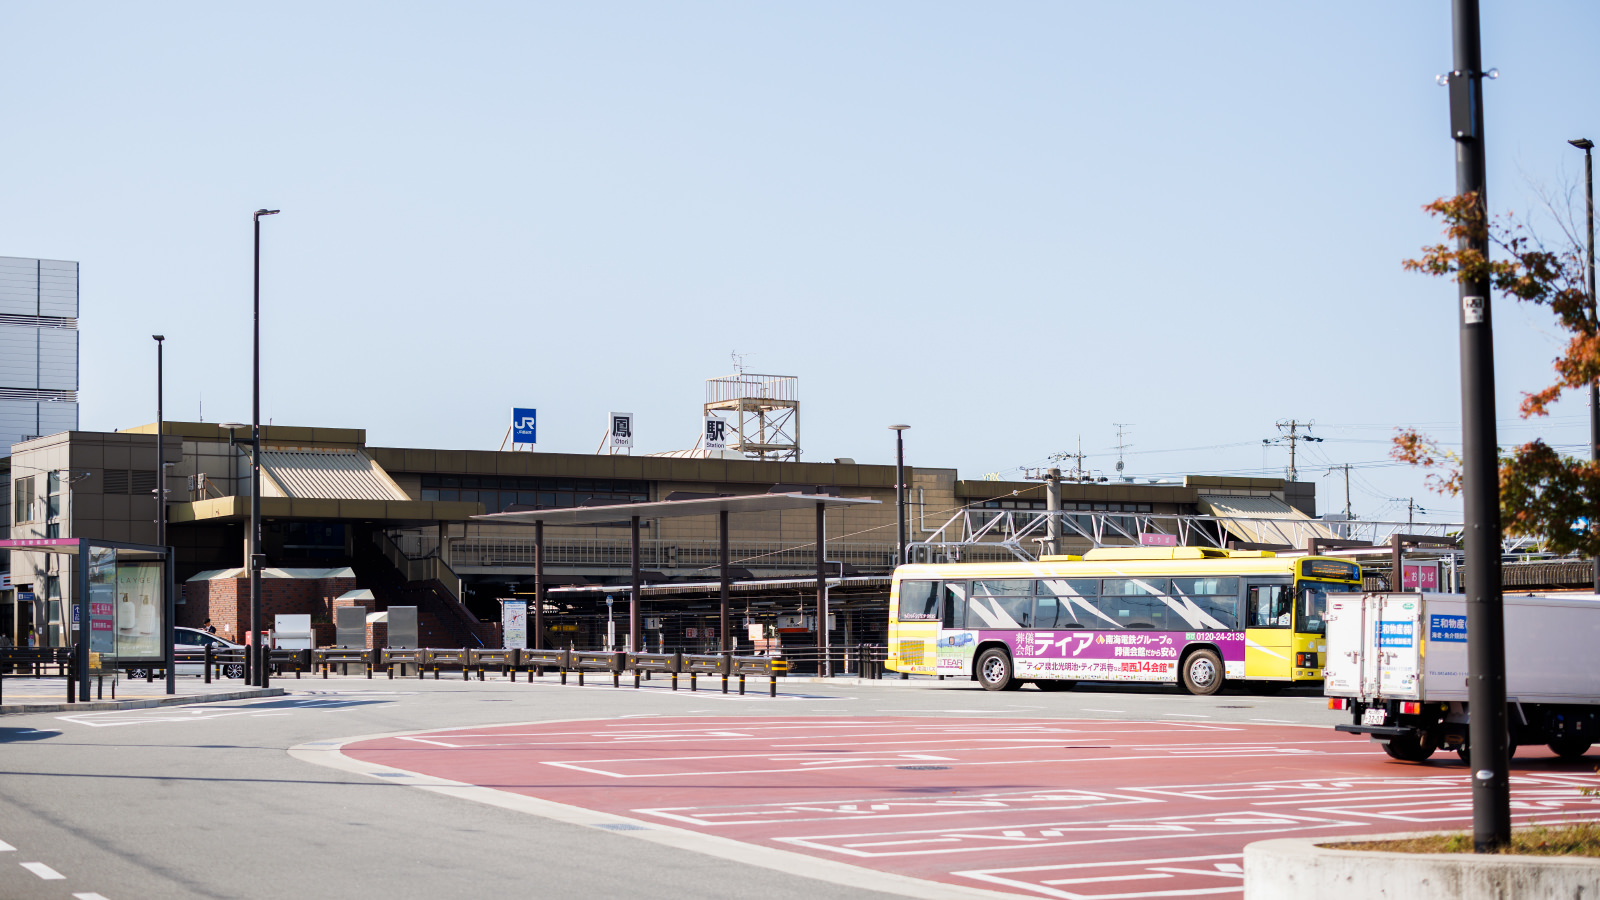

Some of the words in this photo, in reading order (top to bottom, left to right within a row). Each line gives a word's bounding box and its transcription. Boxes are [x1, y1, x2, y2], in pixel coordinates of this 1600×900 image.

[515, 417, 534, 429] JR
[612, 415, 632, 438] 鳳
[706, 420, 725, 442] 駅
[1411, 571, 1434, 582] おりば
[1431, 617, 1468, 630] 三和物産
[1015, 632, 1034, 644] 葬儀
[1105, 634, 1173, 645] 南海電鉄グループの
[1196, 632, 1245, 641] 0120-24-2139
[1015, 644, 1034, 656] 会館
[1034, 632, 1094, 657] ティア
[1114, 646, 1177, 657] 葬儀会館だから安心
[942, 658, 963, 666] TEAR
